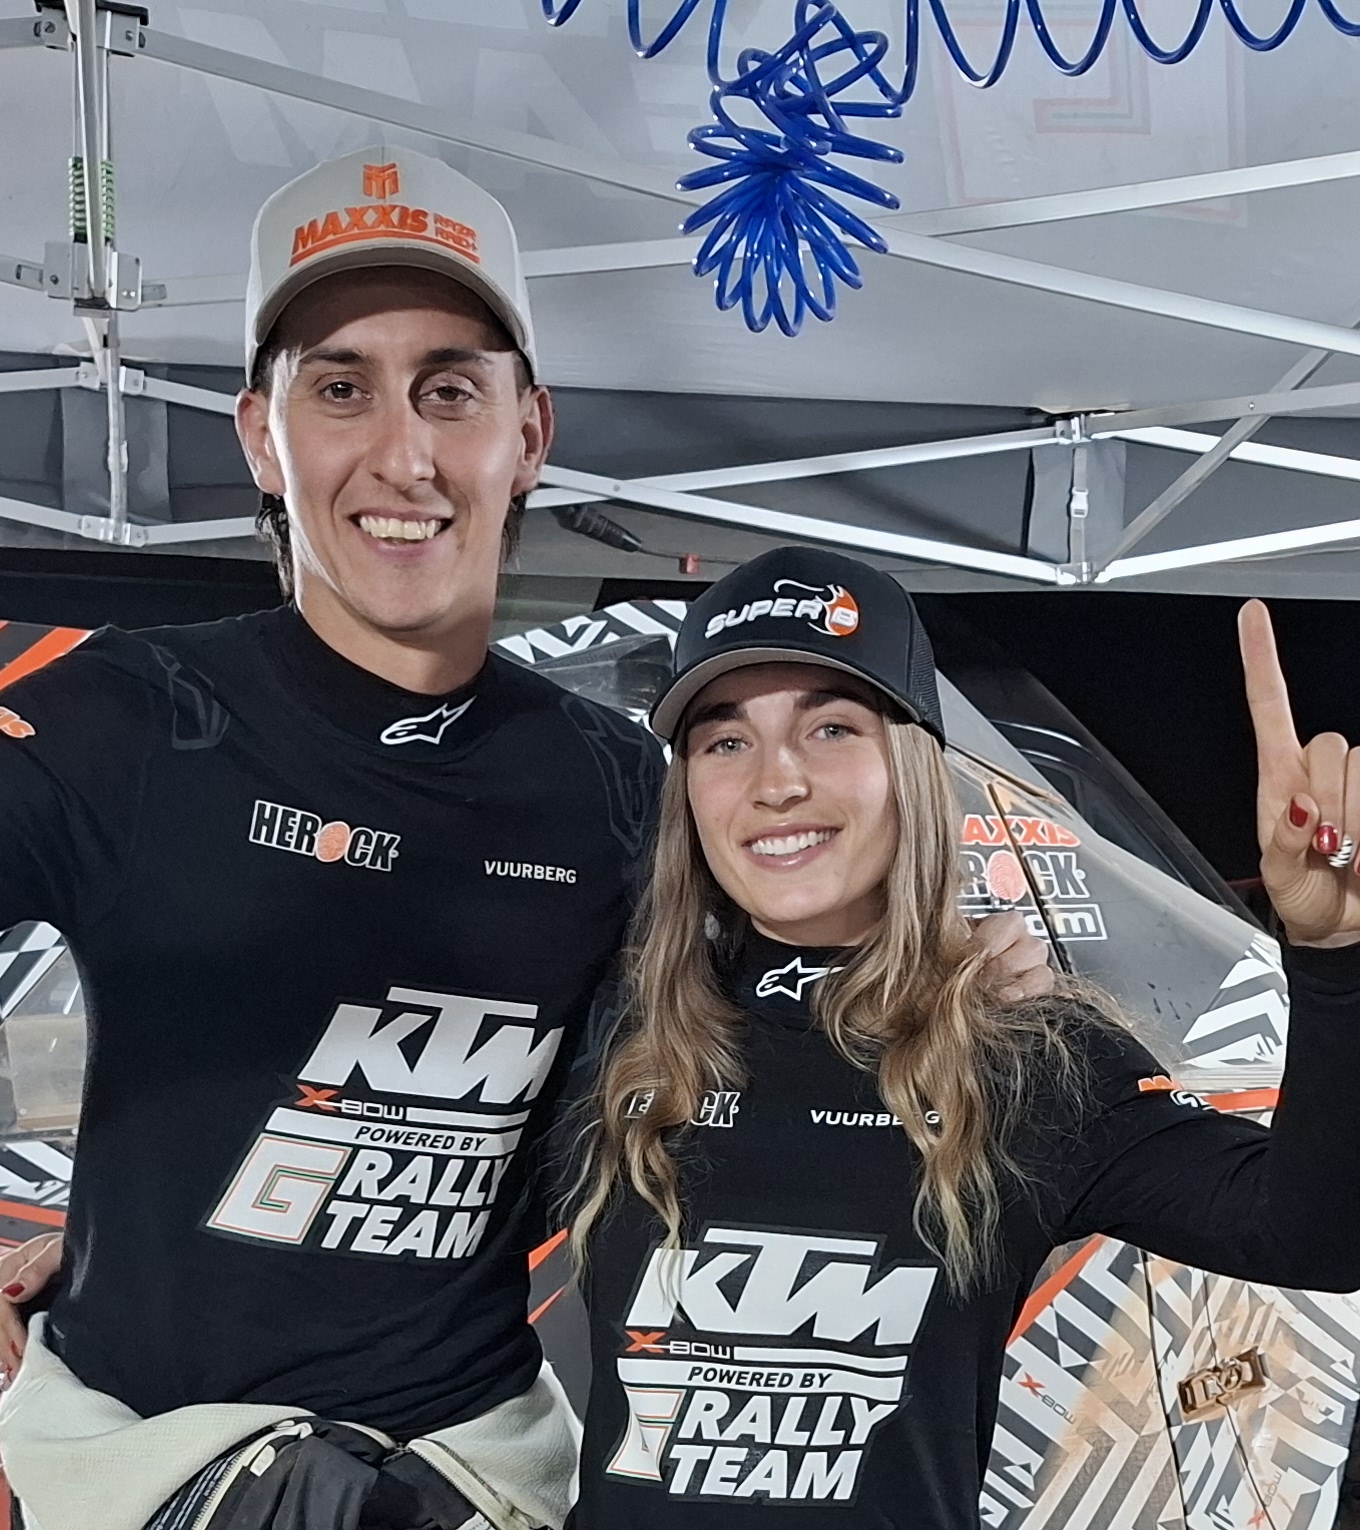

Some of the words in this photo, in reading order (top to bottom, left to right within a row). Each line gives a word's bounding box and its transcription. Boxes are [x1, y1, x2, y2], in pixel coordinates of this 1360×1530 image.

[292, 204, 429, 255] MAXXIS
[705, 598, 823, 639] SUPER
[249, 800, 401, 872] HEROCK
[961, 814, 1082, 847] AXXIS
[484, 860, 577, 884] VUURBERG
[297, 986, 565, 1104] KTM
[354, 1126, 456, 1151] POWERED
[458, 1136, 487, 1153] BY
[337, 1149, 514, 1207] RALLY
[321, 1200, 492, 1258] TEAM
[625, 1228, 938, 1346] KTM
[688, 1366, 795, 1388] POWERED
[799, 1373, 833, 1389] BY
[678, 1390, 899, 1447] RALLY
[669, 1445, 863, 1500] TEAM
